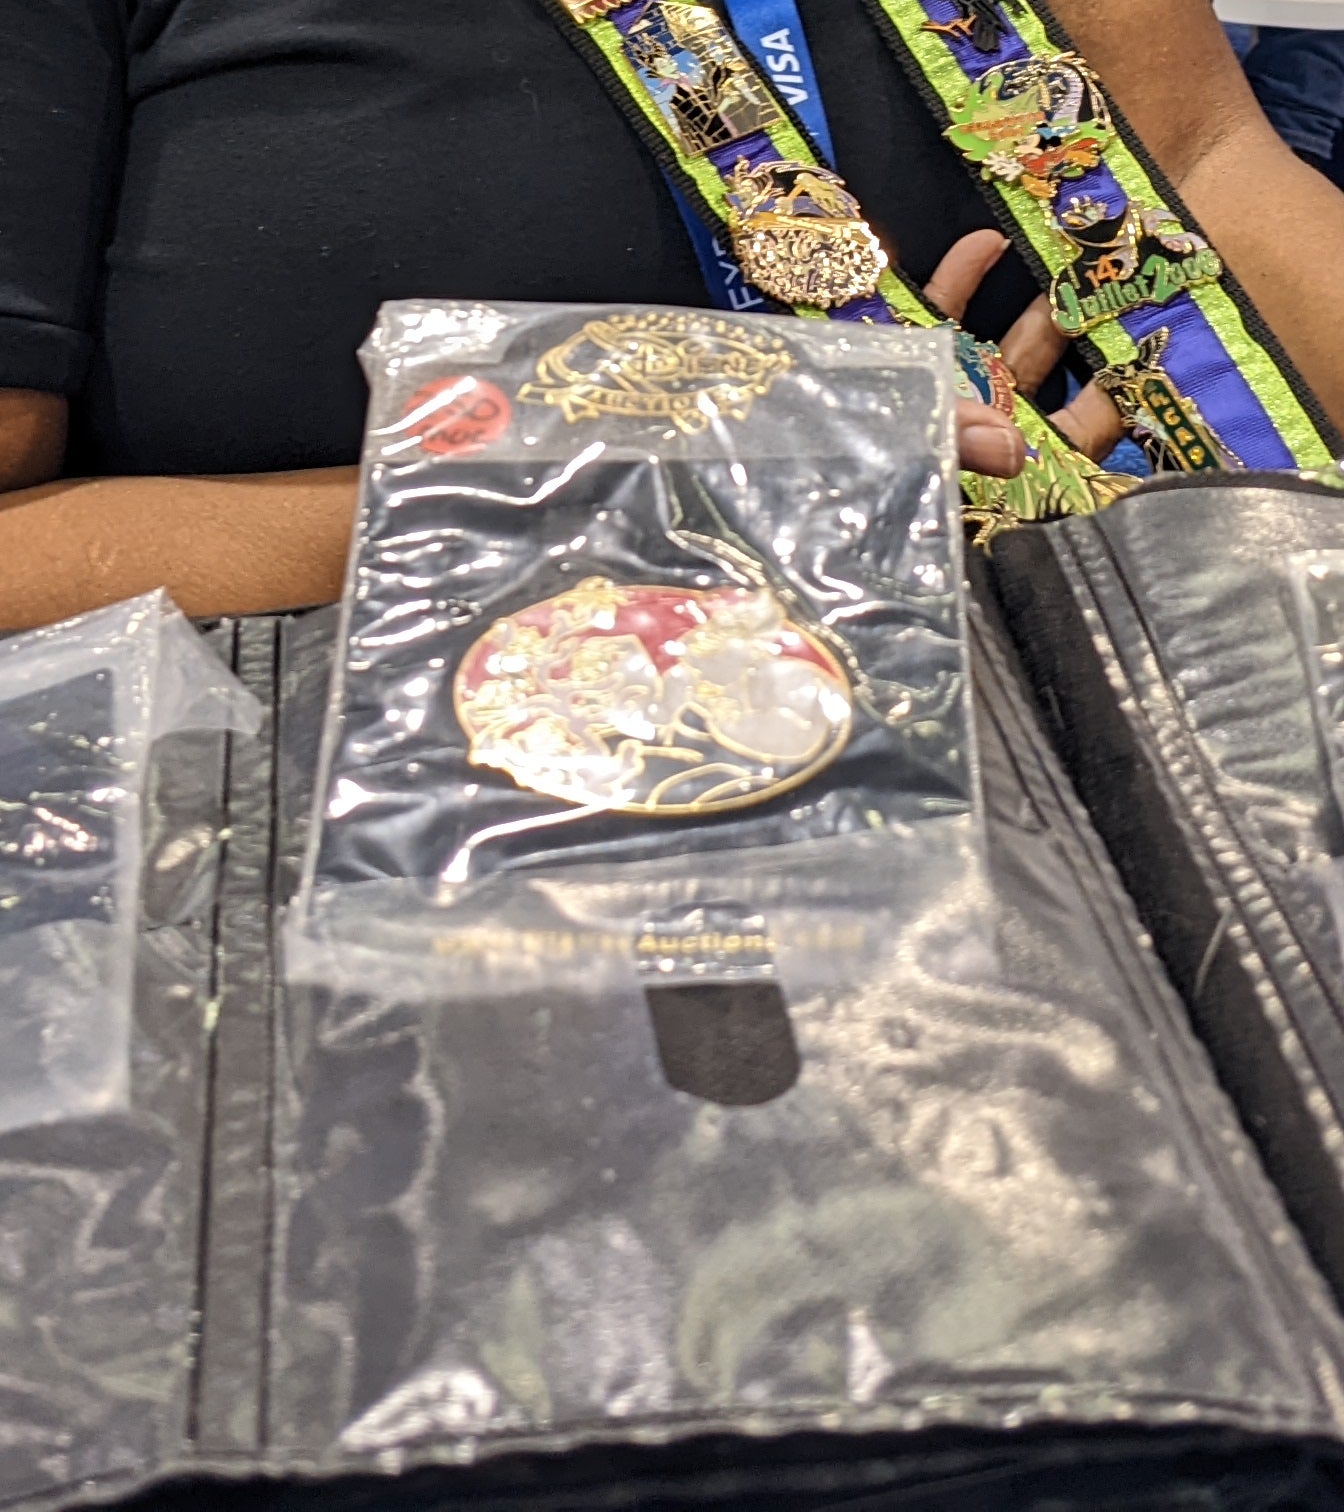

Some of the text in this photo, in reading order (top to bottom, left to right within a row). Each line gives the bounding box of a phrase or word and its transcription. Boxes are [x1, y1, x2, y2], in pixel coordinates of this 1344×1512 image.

[759, 27, 809, 106] VISA
[1084, 254, 1120, 288] 14
[1056, 277, 1151, 331] Juillet
